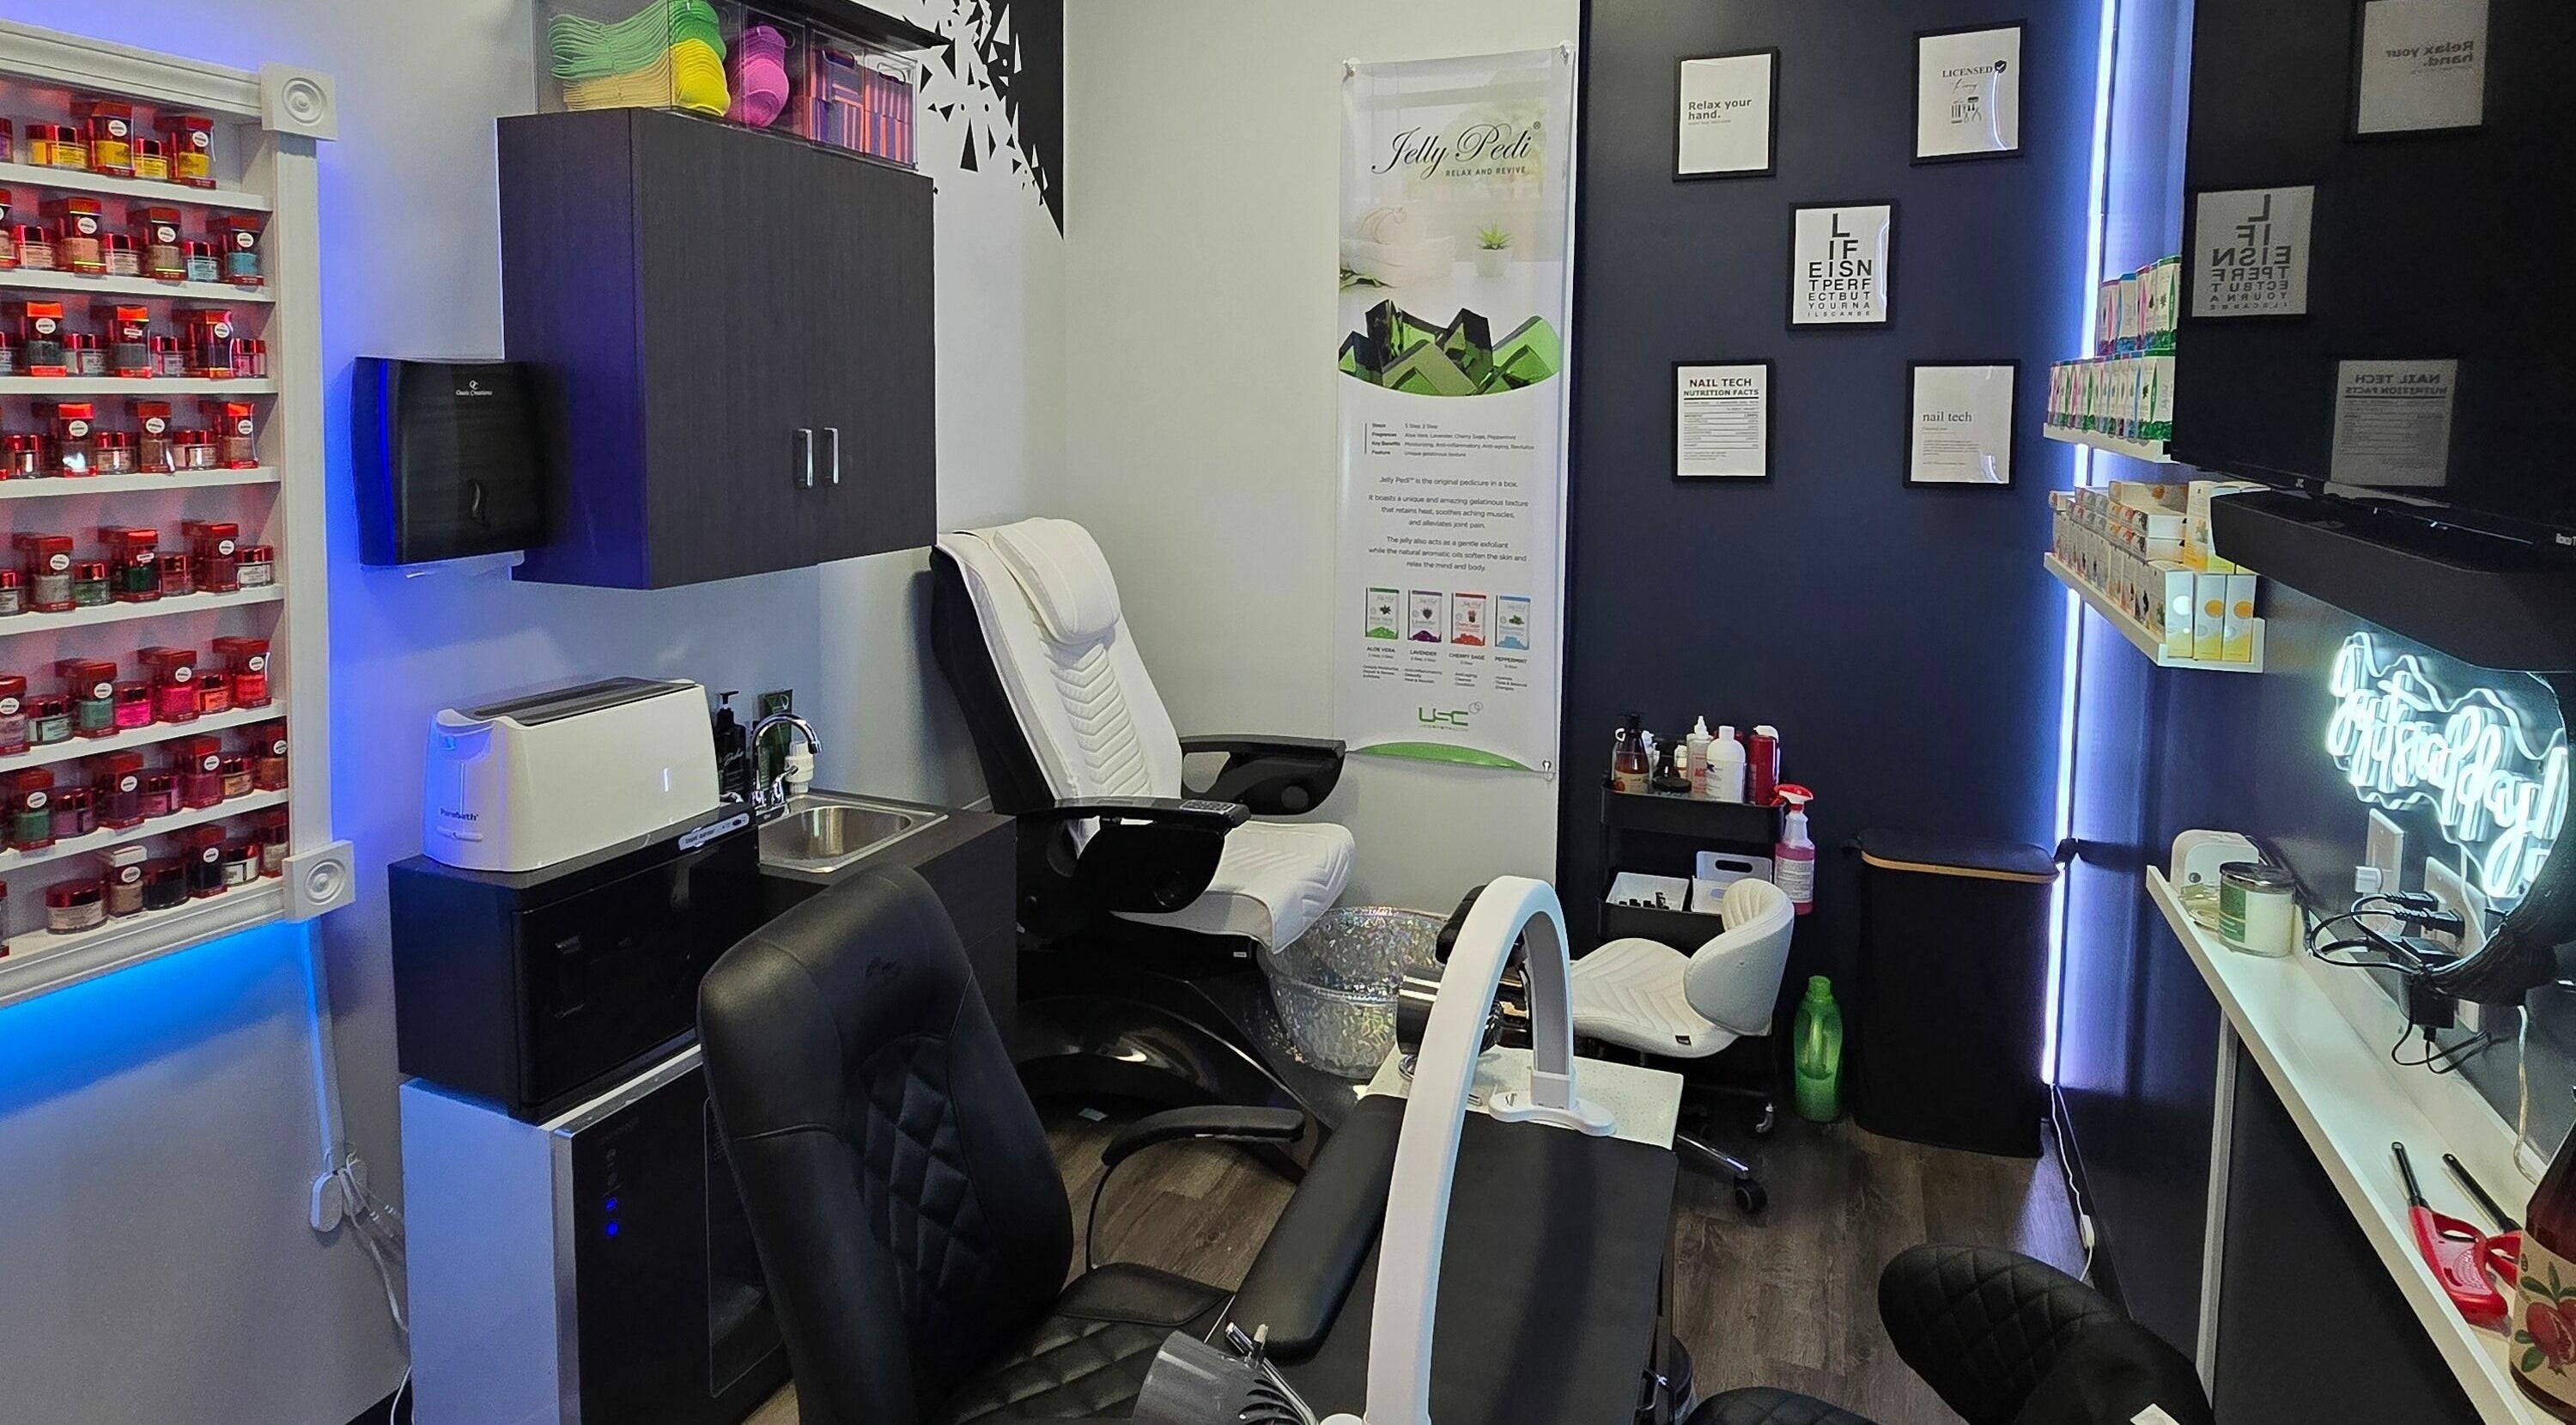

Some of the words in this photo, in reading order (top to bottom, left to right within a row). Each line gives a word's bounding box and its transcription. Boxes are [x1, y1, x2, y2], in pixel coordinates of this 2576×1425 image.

[1941, 65, 1993, 78] LICENSED
[1688, 100, 1721, 110] Relax
[1724, 99, 1752, 110] your
[1688, 110, 1721, 120] hand.
[1371, 127, 1449, 180] Jelly
[1496, 166, 1526, 174] REVIVE
[1832, 213, 1850, 238] L
[1689, 379, 1718, 387] NAIL
[1722, 378, 1752, 387] TECH
[1923, 411, 1945, 422] nail
[1947, 411, 1972, 422] tech
[1419, 707, 1469, 727] USC
